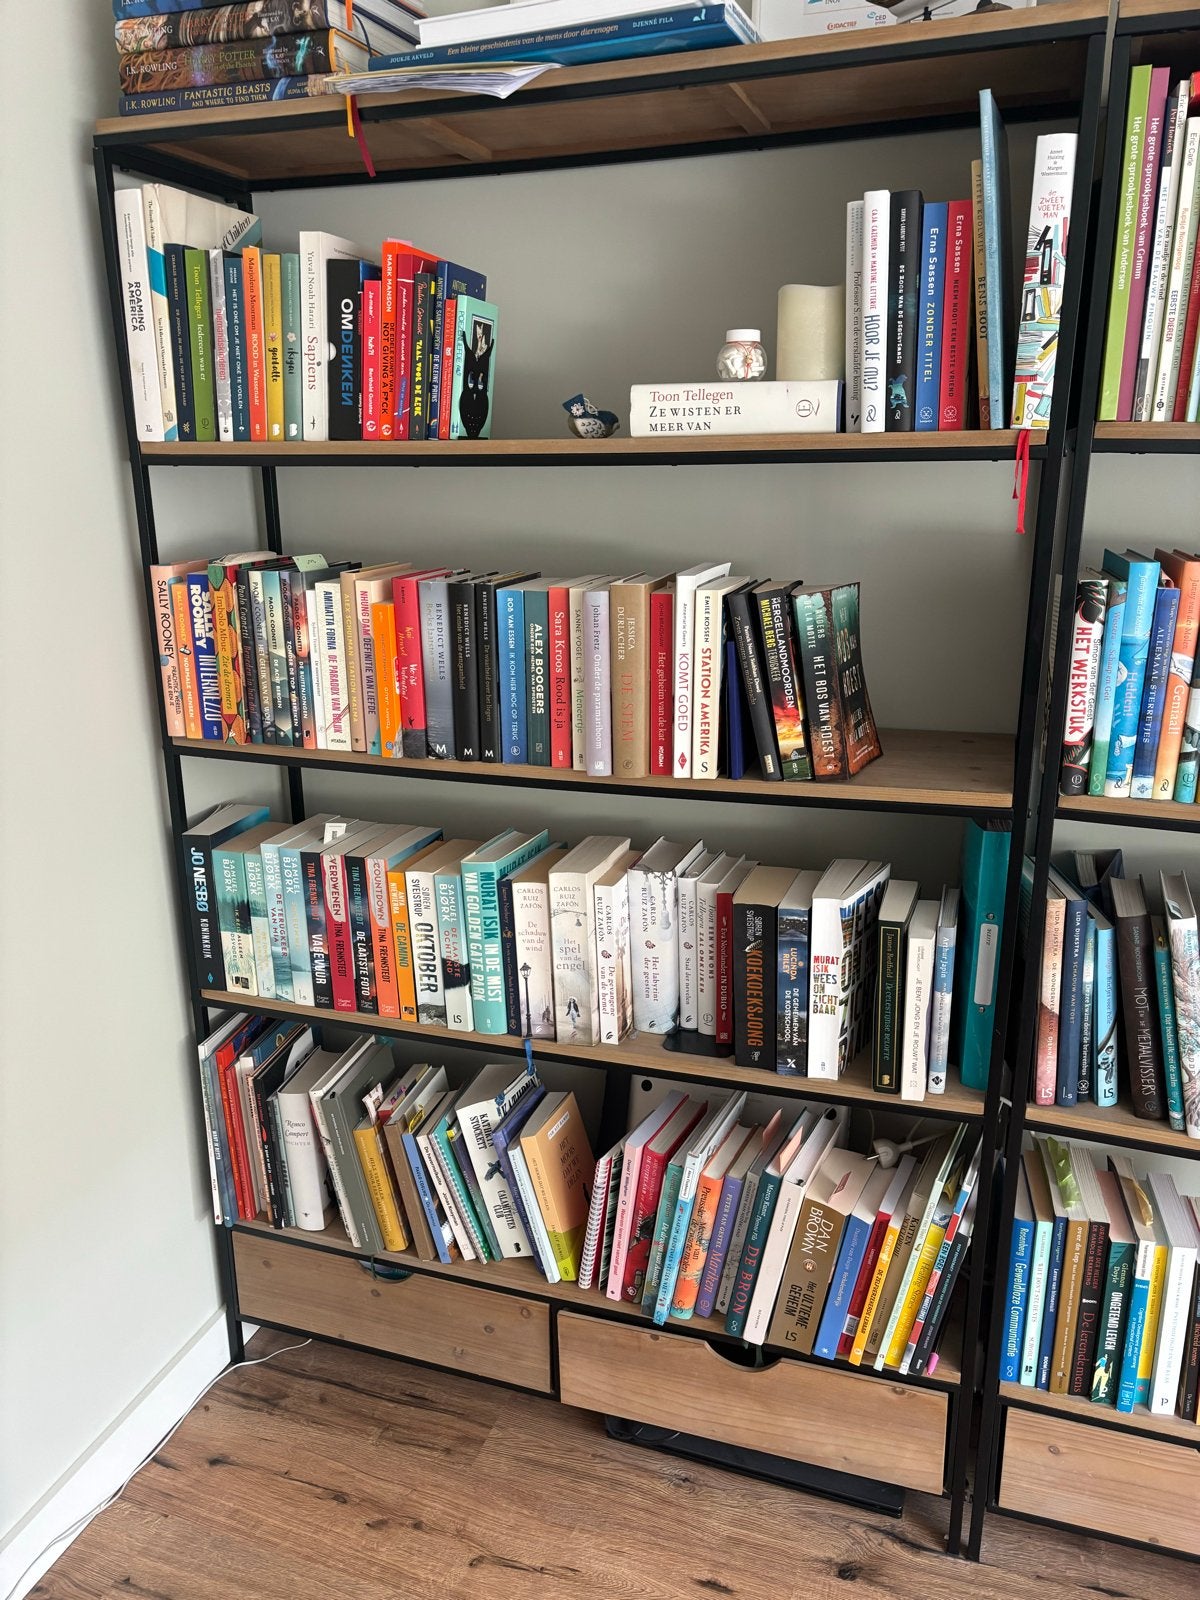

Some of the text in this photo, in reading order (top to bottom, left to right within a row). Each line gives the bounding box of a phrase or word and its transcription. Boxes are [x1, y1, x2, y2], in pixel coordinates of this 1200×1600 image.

[447, 25, 618, 55] Een kleine geschiedenis van de mens door dierenogen
[126, 97, 176, 110] J.K. ROWLING
[185, 83, 270, 99] FANTASTIC BEASTS
[205, 98, 225, 106] WHERE
[1118, 117, 1142, 289] Het grote sprookjesboek van Andersen
[1134, 118, 1160, 279] Het grote sprookjesboek van Grimm
[928, 228, 938, 295] Erna Sassen
[954, 215, 964, 273] Erna Sassen
[127, 282, 138, 331] AMERICA
[134, 282, 145, 331] ROAMING
[195, 289, 203, 319] Tellegen
[978, 277, 988, 340] BENS BOOT
[304, 336, 318, 390] Sapiens
[650, 389, 733, 404] Toon Tellegen
[650, 422, 711, 431] MEER VAN
[158, 580, 174, 658] SALLY ROONEY
[190, 585, 206, 649] ROONEY
[324, 591, 336, 650] AMINATTA FORNA
[436, 604, 446, 680] BENEDICT WELLS
[555, 612, 565, 672] Sara Kroos
[184, 658, 192, 689] NORMALE
[364, 638, 375, 714] DEFINITIE VAN LIEFDE
[535, 624, 544, 714] ALEX BOOGERS
[678, 654, 689, 731] KOMT GOED
[1069, 628, 1092, 735] HET WERKSTUK
[1087, 639, 1101, 720] Simon van der Geest
[700, 648, 711, 755] STATION AMERIKA
[813, 656, 834, 758] HET BOS VAN ROEST
[190, 847, 208, 912] JO NESBØ
[329, 859, 341, 916] VERDWENEN
[373, 863, 384, 920] COUNTDOWN
[480, 872, 498, 939] MURAT ISIK
[200, 919, 211, 958] KONINKRIJK
[396, 922, 408, 967] DE CAMINO
[415, 923, 438, 992] OKTOBER
[560, 944, 581, 955] spel
[790, 948, 798, 980] LUCINDA
[485, 944, 501, 1002] IN DE MIST
[557, 961, 585, 971] engel
[608, 967, 615, 976] De
[721, 976, 727, 984] IN
[746, 951, 763, 1046] KOEKOEKSJONG
[1134, 987, 1148, 1010] MOT
[913, 1021, 920, 1029] EN
[1137, 1028, 1155, 1095] METAALVISSERS
[470, 1116, 487, 1150] STOCKETT
[493, 1204, 503, 1218] CLUB
[695, 1187, 711, 1219] Preussler
[715, 1193, 733, 1247] PETER VAN GESTEL
[685, 1228, 697, 1251] zwarte
[801, 1206, 823, 1254] BROWN
[815, 1219, 834, 1253] DAN
[1015, 1228, 1029, 1255] Rosenberg
[681, 1253, 693, 1272] molen
[704, 1250, 723, 1293] Mariken
[733, 1245, 759, 1314] DE BRON
[784, 1285, 802, 1316] GEHEIM
[796, 1281, 817, 1329] Het ULTIEME
[1007, 1263, 1026, 1356] Geweldloze Communicatie
[1073, 1312, 1095, 1392] De lerende mens
